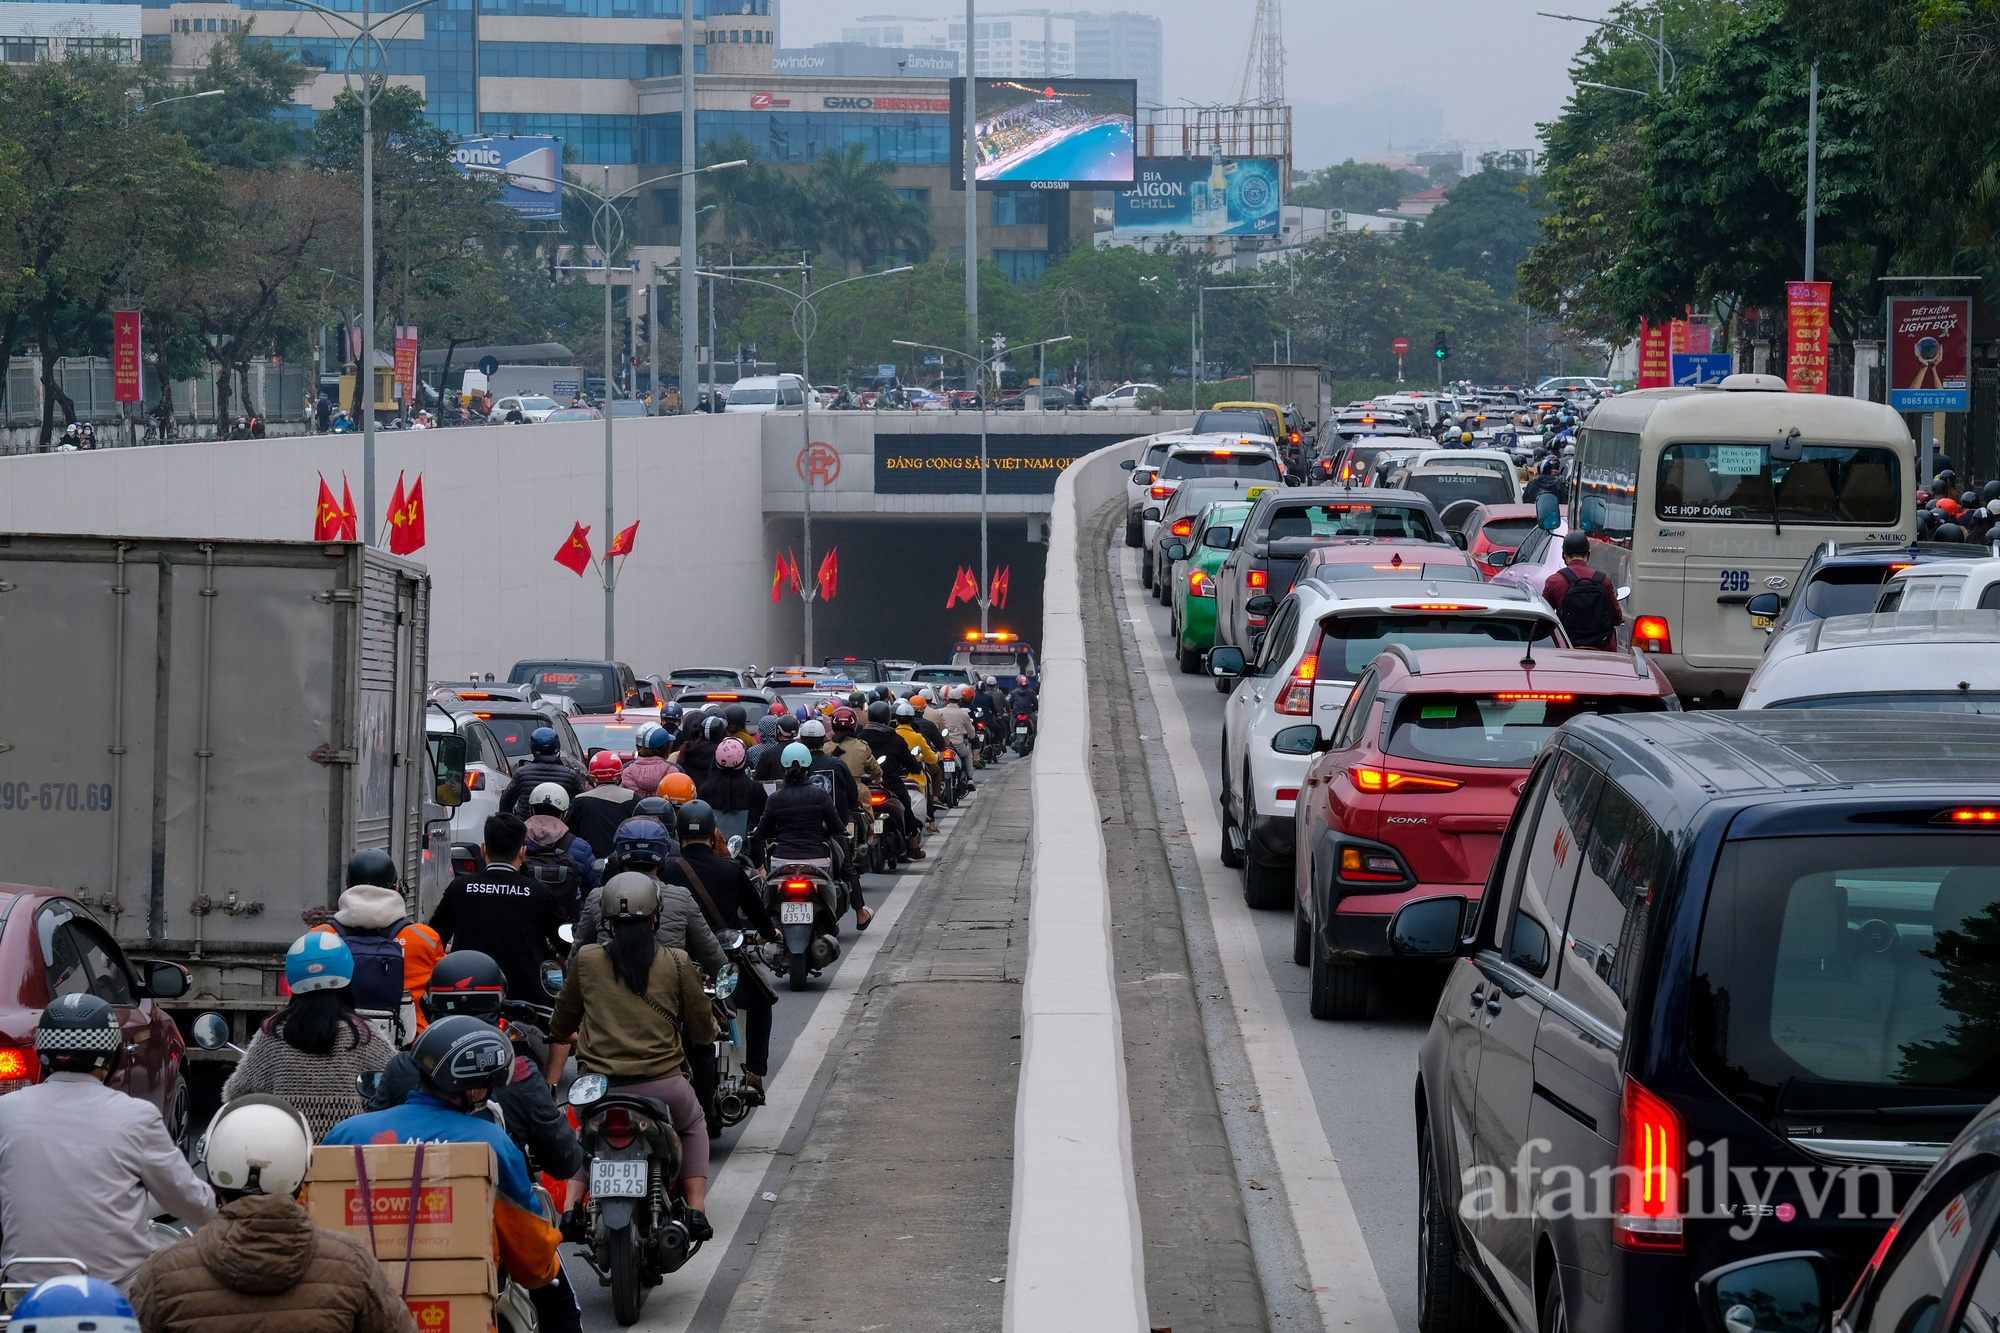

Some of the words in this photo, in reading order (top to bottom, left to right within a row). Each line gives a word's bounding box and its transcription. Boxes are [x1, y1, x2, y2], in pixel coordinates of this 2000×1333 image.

[773, 55, 826, 69] owindow
[908, 54, 954, 70] Eurowindow
[824, 97, 872, 108] GMO
[447, 145, 501, 165] sonic
[1144, 172, 1161, 181] BIA
[1130, 199, 1176, 208] CHILL
[1899, 322, 1932, 333] LIGHT
[1932, 319, 1958, 330] BOX
[886, 456, 923, 469] ĐẢNG
[926, 457, 962, 470] CỘNG
[993, 457, 1022, 470] VIỆT
[1024, 458, 1054, 469] NAM
[1056, 458, 1078, 470] QU
[1664, 506, 1677, 514] XE
[1681, 506, 1700, 516] HỢP
[1720, 570, 1750, 592] 29B
[0, 781, 112, 812] 9C-670.69
[466, 883, 530, 896] ESSENTIALS
[786, 904, 808, 913] 29-T1
[784, 913, 810, 922] 835.79
[599, 1164, 638, 1178] 90-B1
[594, 1179, 643, 1194] 685.25
